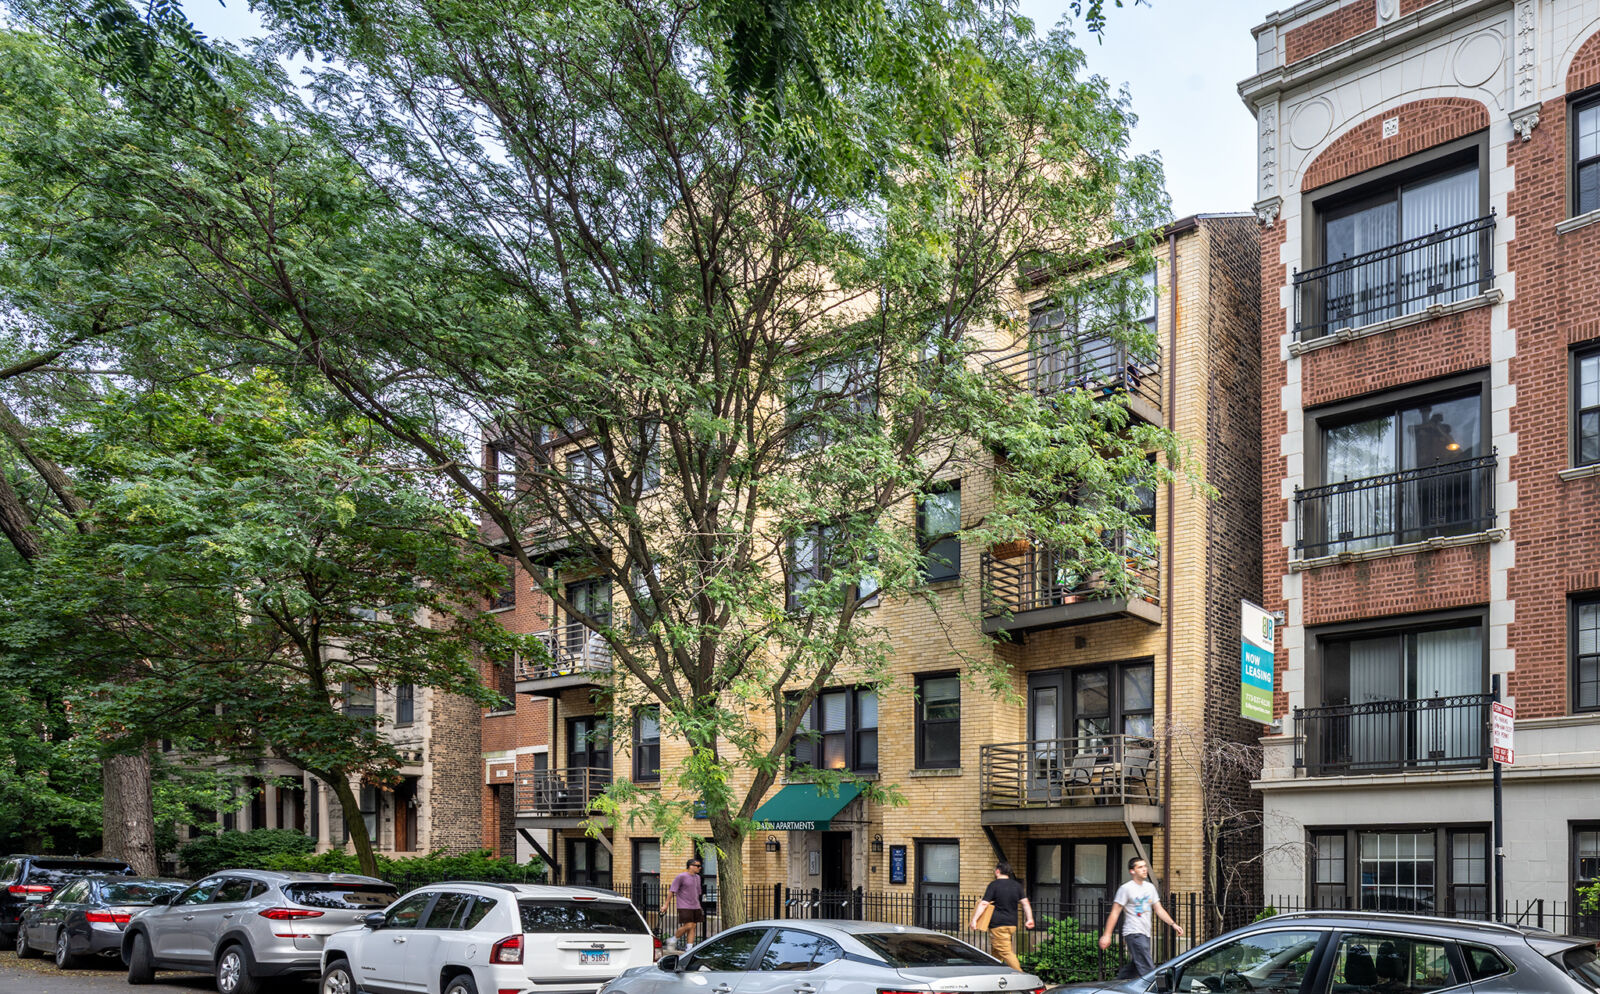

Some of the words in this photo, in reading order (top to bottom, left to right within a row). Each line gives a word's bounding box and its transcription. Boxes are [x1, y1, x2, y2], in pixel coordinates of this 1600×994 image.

[1245, 651, 1261, 666] NOW
[1245, 664, 1272, 683] LEASING
[776, 822, 814, 830] APARTMENTS
